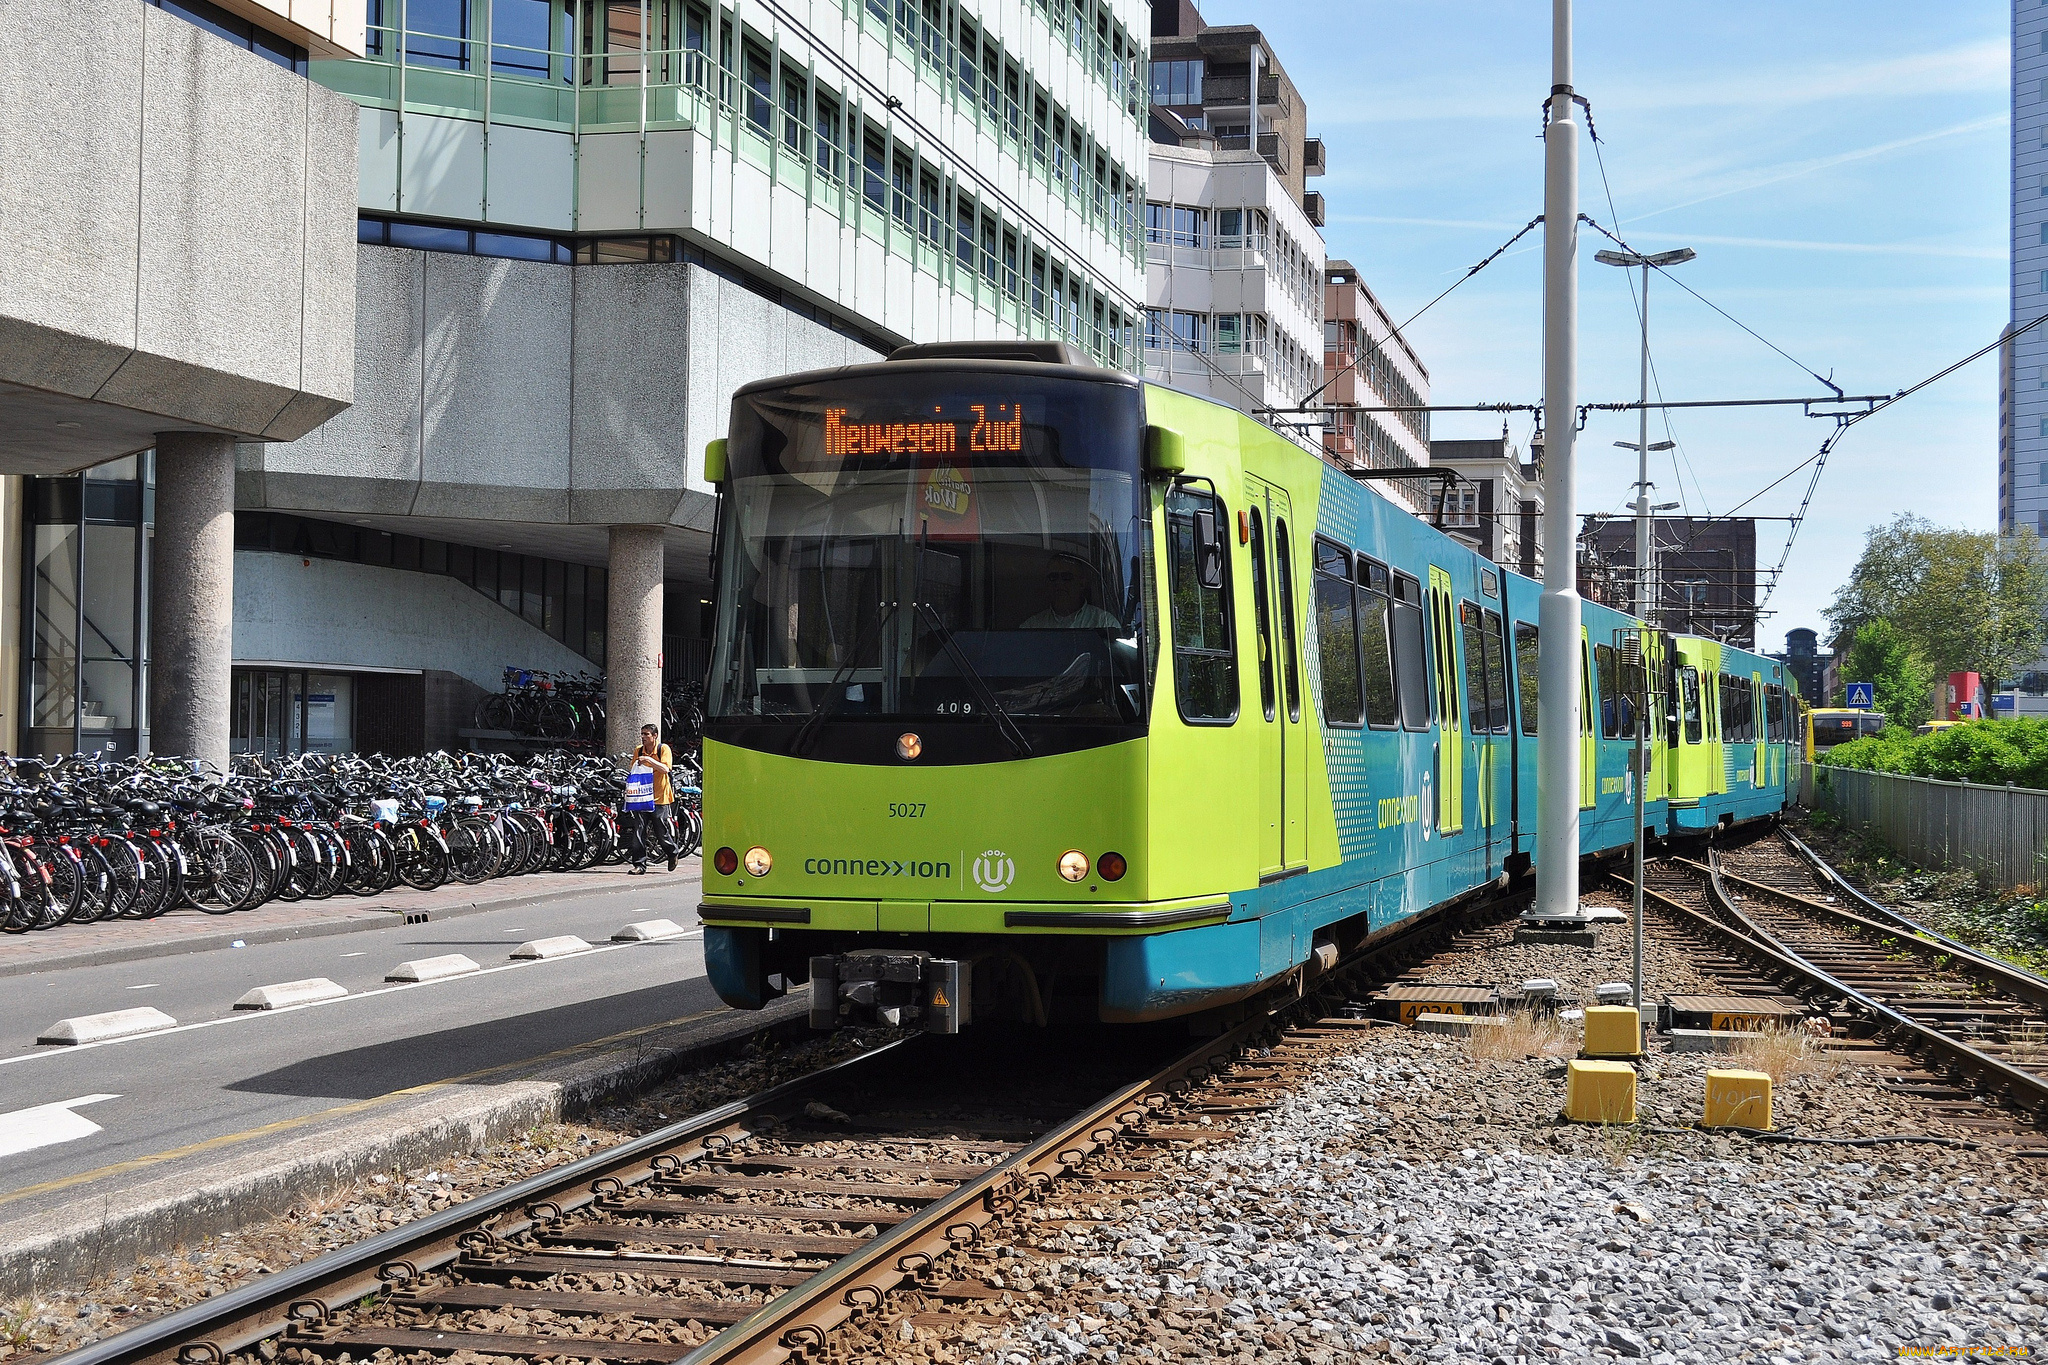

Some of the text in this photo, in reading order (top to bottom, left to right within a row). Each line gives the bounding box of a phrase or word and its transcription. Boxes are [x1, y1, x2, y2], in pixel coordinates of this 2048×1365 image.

[826, 404, 1021, 455] Nieuwegein Zuid
[936, 702, 972, 714] 409
[889, 803, 926, 818] 5027
[804, 858, 951, 878] connexxion
